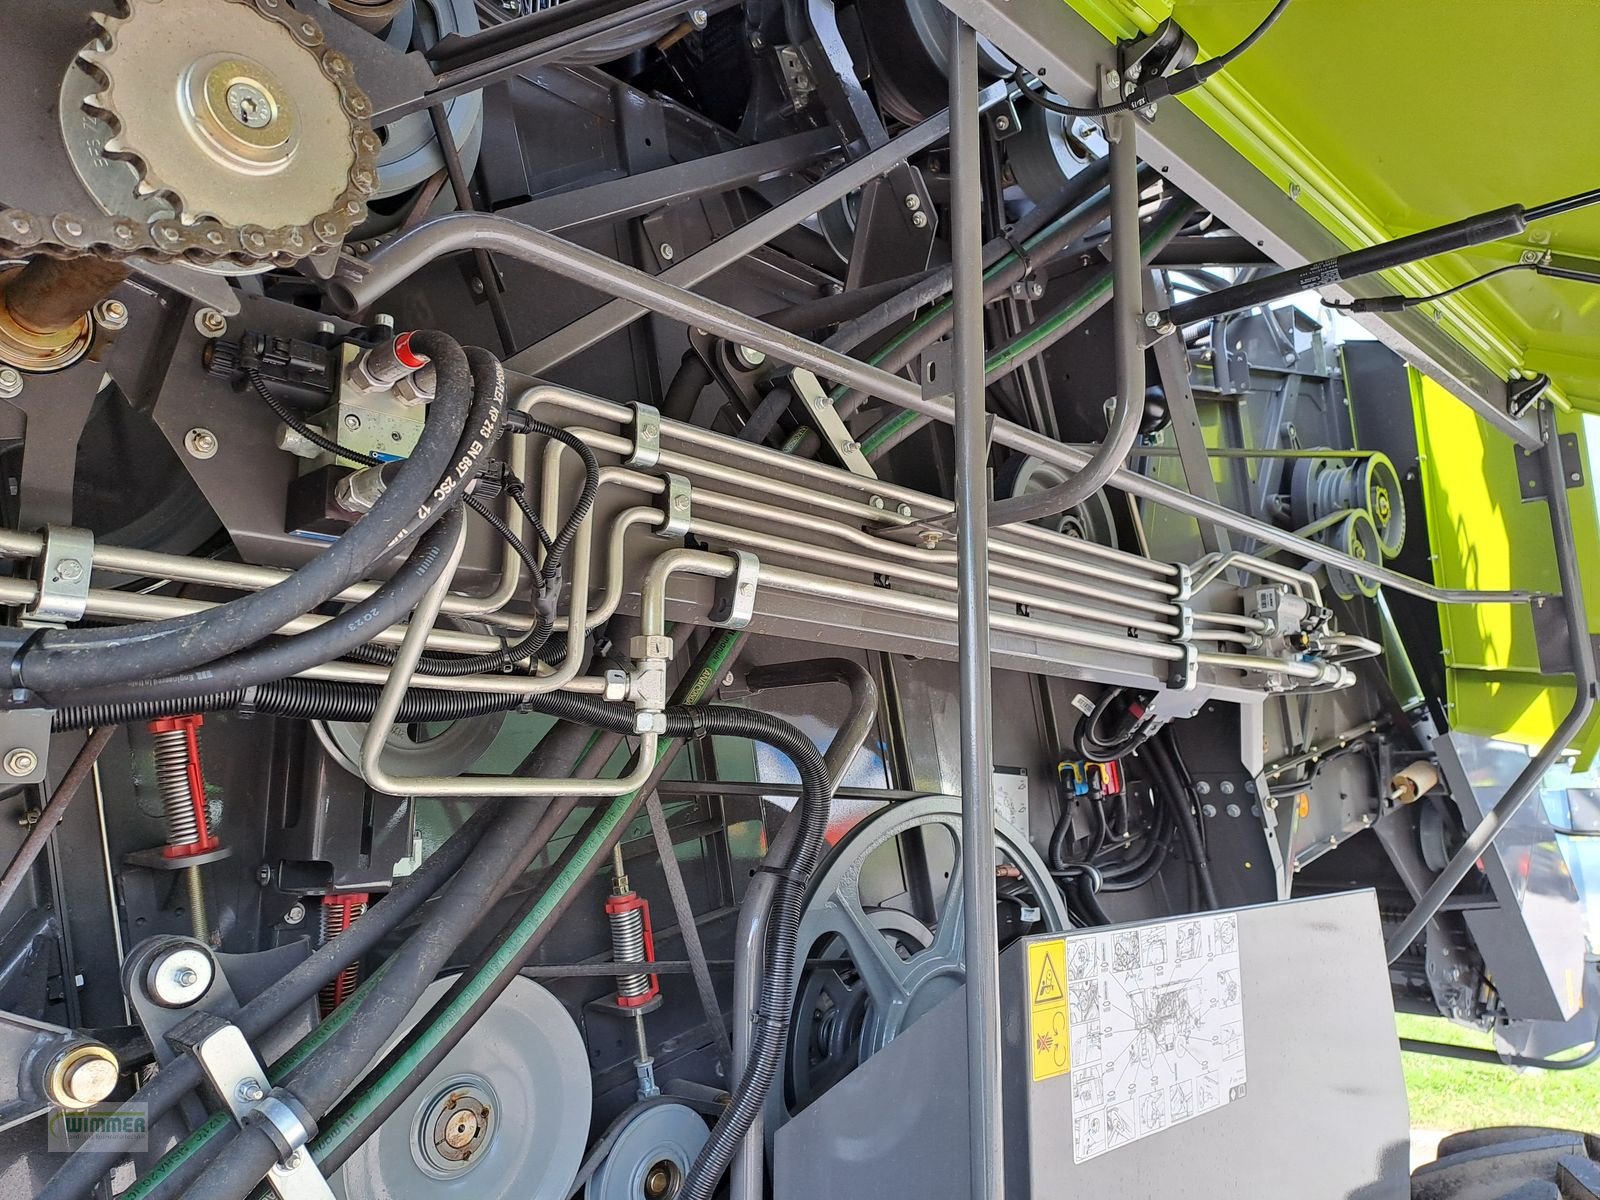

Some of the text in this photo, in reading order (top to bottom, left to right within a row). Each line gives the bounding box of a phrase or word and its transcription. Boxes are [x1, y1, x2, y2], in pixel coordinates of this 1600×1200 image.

[487, 405, 501, 423] KP
[479, 417, 496, 438] 213
[466, 440, 484, 461] EN
[457, 457, 475, 480] 857
[433, 475, 458, 502] 2SC
[416, 503, 433, 521] 12
